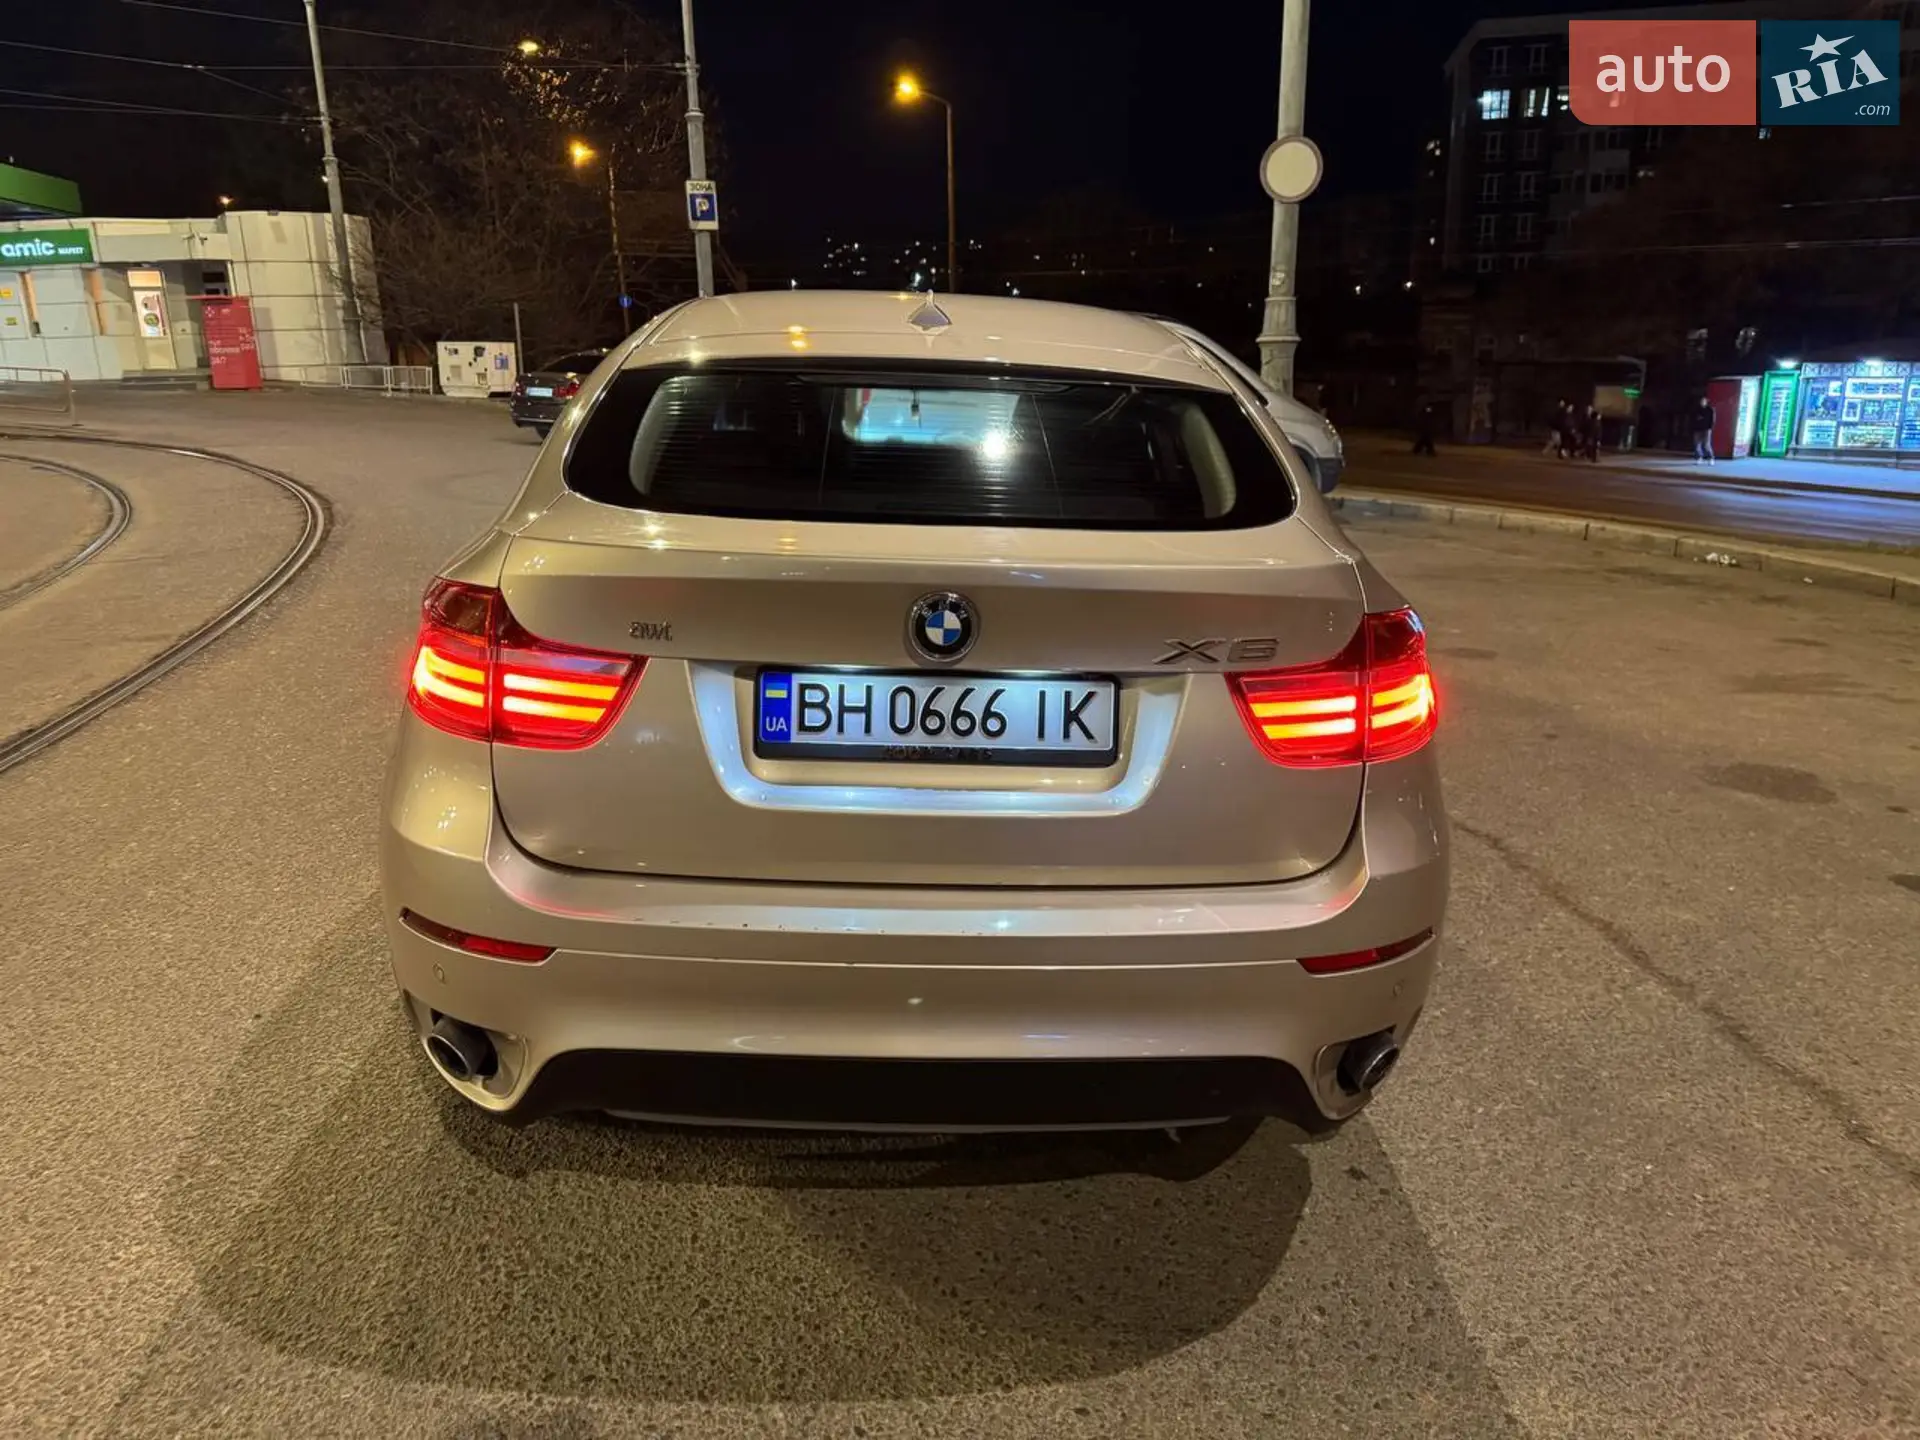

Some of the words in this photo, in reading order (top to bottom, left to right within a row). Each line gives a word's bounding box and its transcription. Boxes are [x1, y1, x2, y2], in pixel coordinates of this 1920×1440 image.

[1, 238, 56, 257] amic
[1152, 637, 1280, 665] X6
[797, 682, 873, 735] BH
[889, 685, 1008, 738] 0666
[1037, 689, 1099, 742] IK
[765, 719, 788, 733] UA
